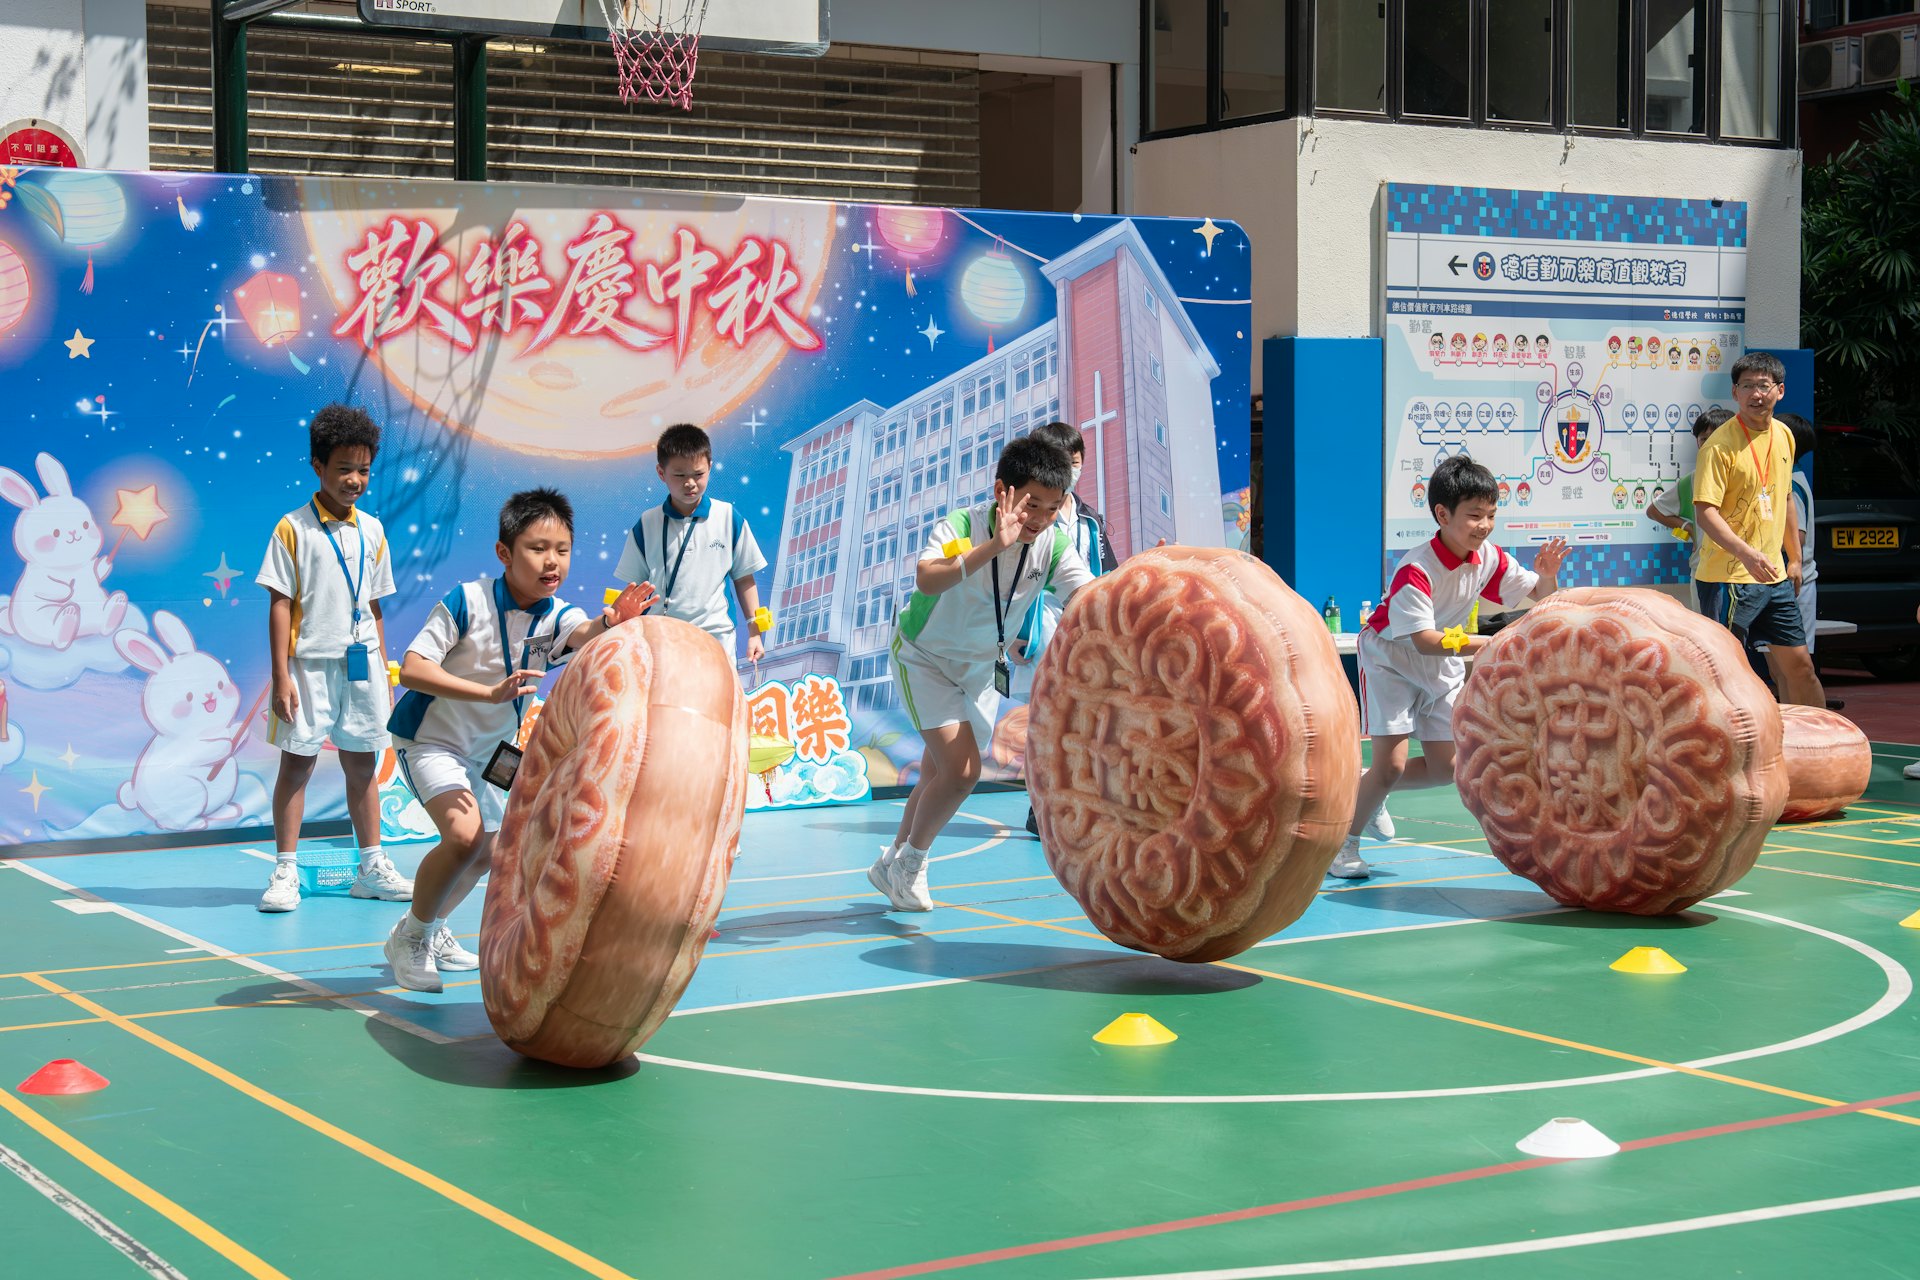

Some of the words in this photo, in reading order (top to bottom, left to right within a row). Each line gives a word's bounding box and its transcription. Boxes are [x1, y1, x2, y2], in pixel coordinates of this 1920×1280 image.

[396, 0, 432, 12] SPORT
[10, 142, 59, 153] 不可阻塞
[1501, 254, 1686, 286] 德信勤而樂價值觀教育
[332, 213, 825, 367] 歡樂慶中秋
[1564, 345, 1586, 359] 智慧
[1400, 457, 1424, 472] 仁愛
[1836, 530, 1855, 546] EW
[1859, 530, 1895, 545] 2922
[747, 680, 847, 759] 同樂
